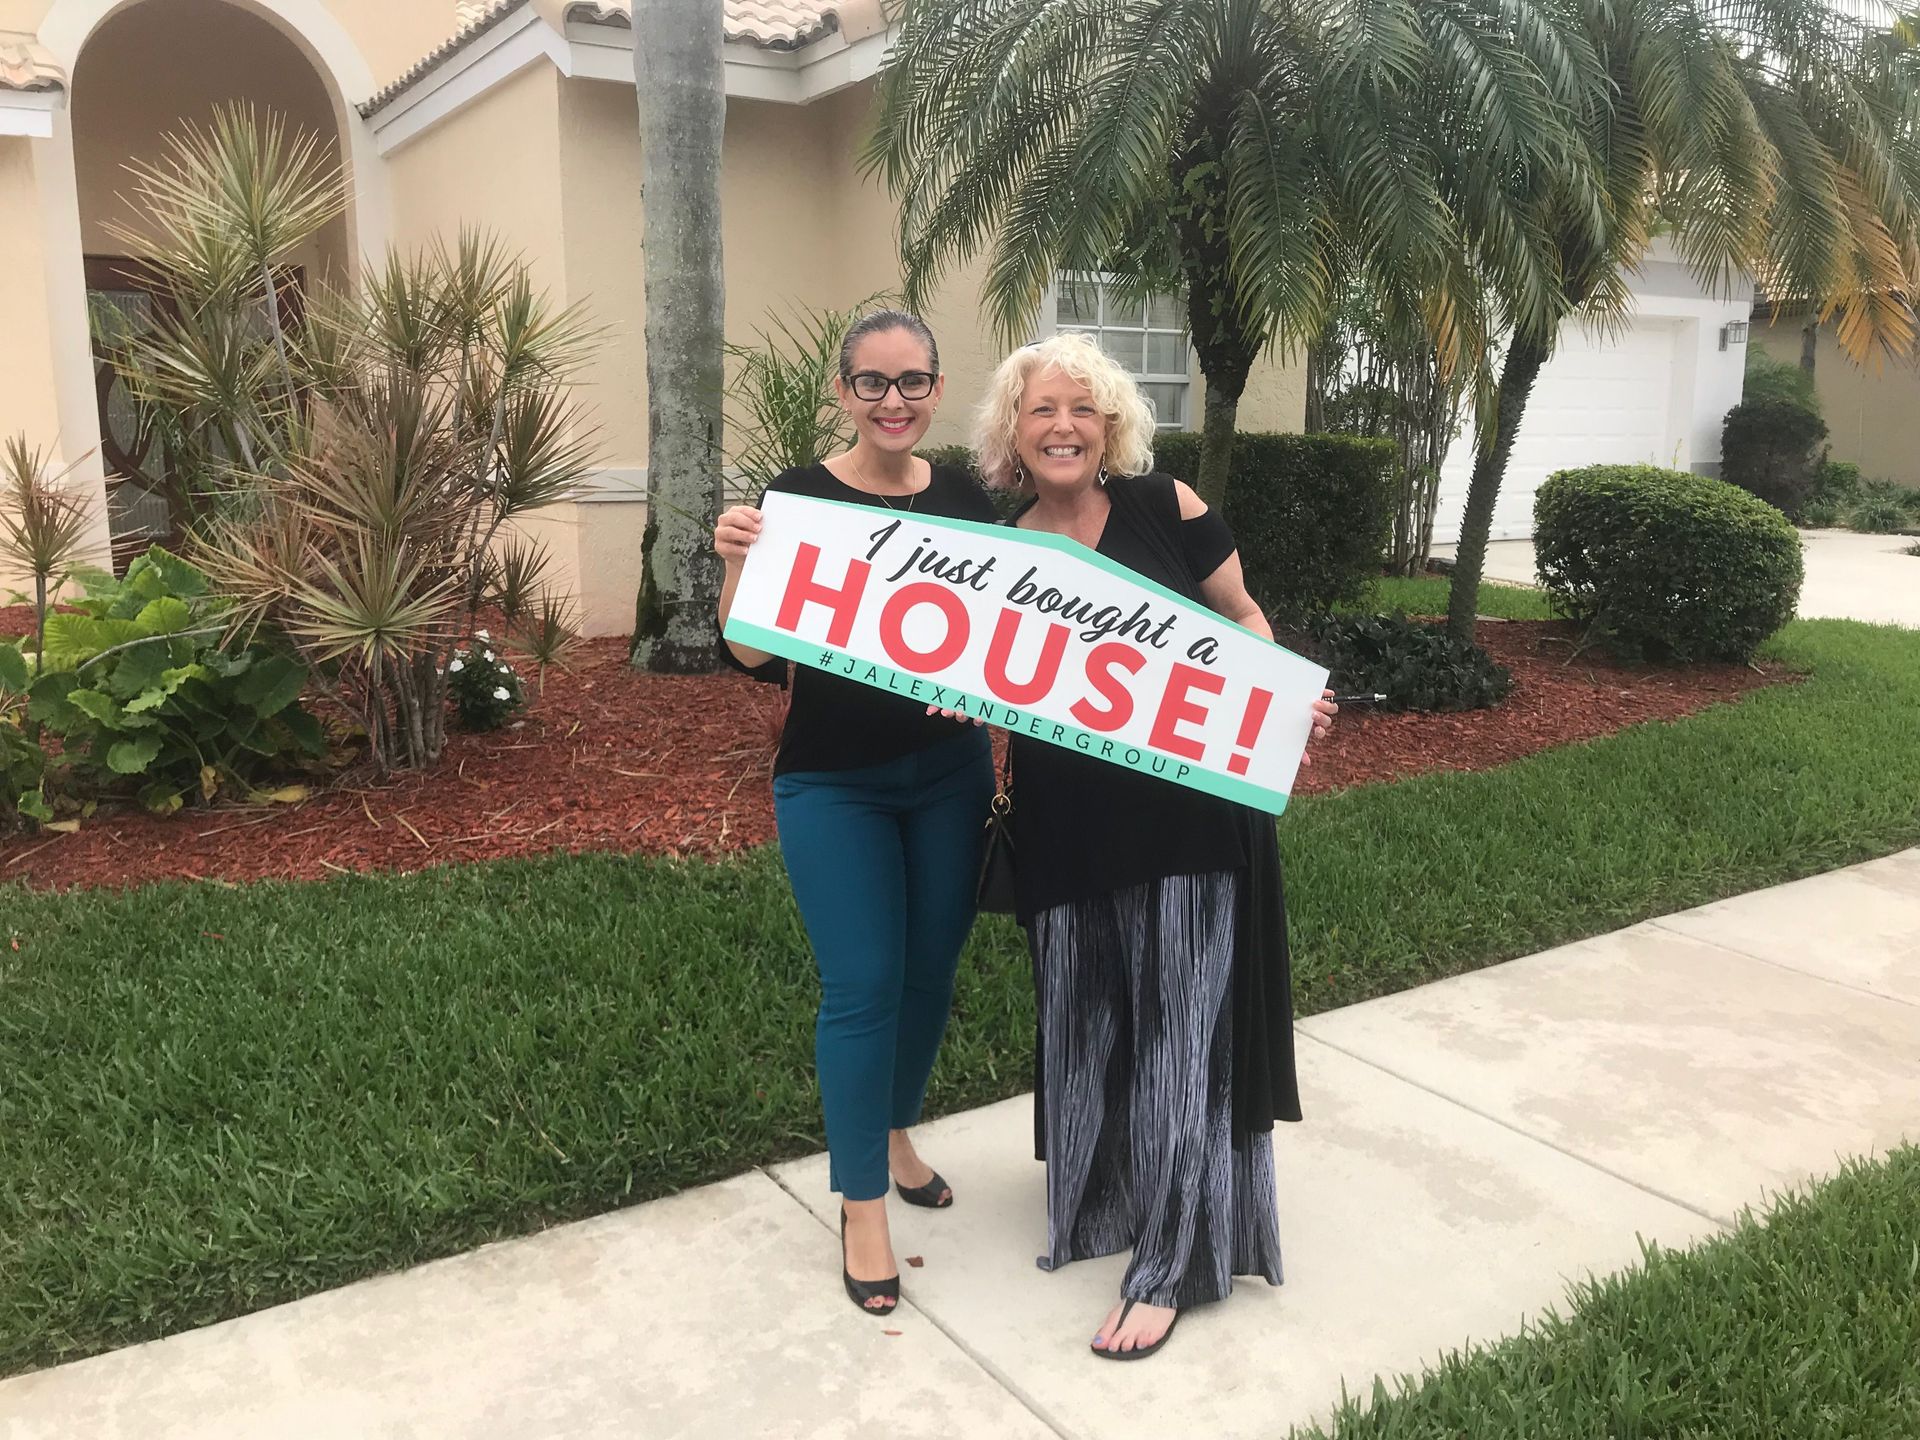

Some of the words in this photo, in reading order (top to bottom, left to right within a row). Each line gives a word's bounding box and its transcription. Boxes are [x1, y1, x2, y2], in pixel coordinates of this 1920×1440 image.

[774, 541, 1273, 776] HOUSE!
[885, 537, 997, 592] just
[1005, 565, 1178, 649] bought
[1186, 636, 1219, 666] a
[818, 650, 1191, 780] #JALEXANDERGROUP
